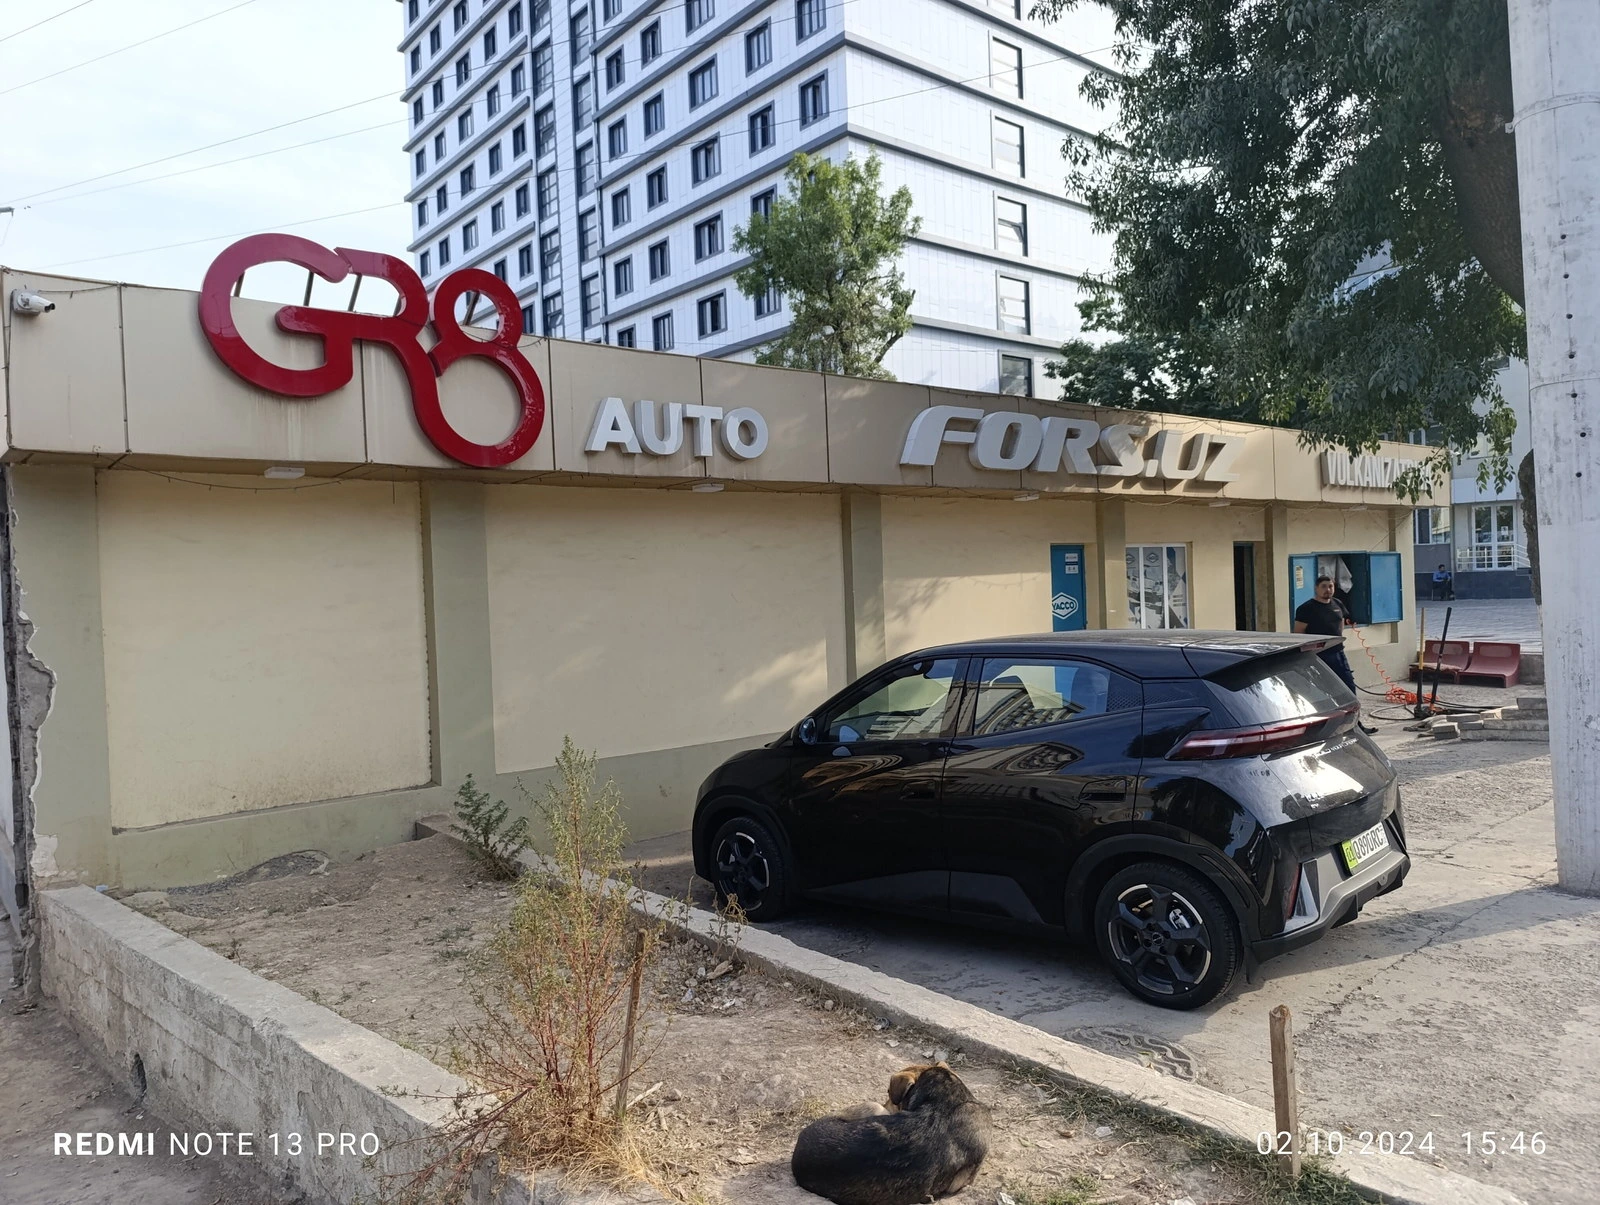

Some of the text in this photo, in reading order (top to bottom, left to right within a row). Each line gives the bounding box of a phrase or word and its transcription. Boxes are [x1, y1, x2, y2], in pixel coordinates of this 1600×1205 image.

[198, 233, 546, 468] GR8
[584, 396, 1247, 483] AUTO FORS.UZ
[1052, 601, 1075, 611] YACCO
